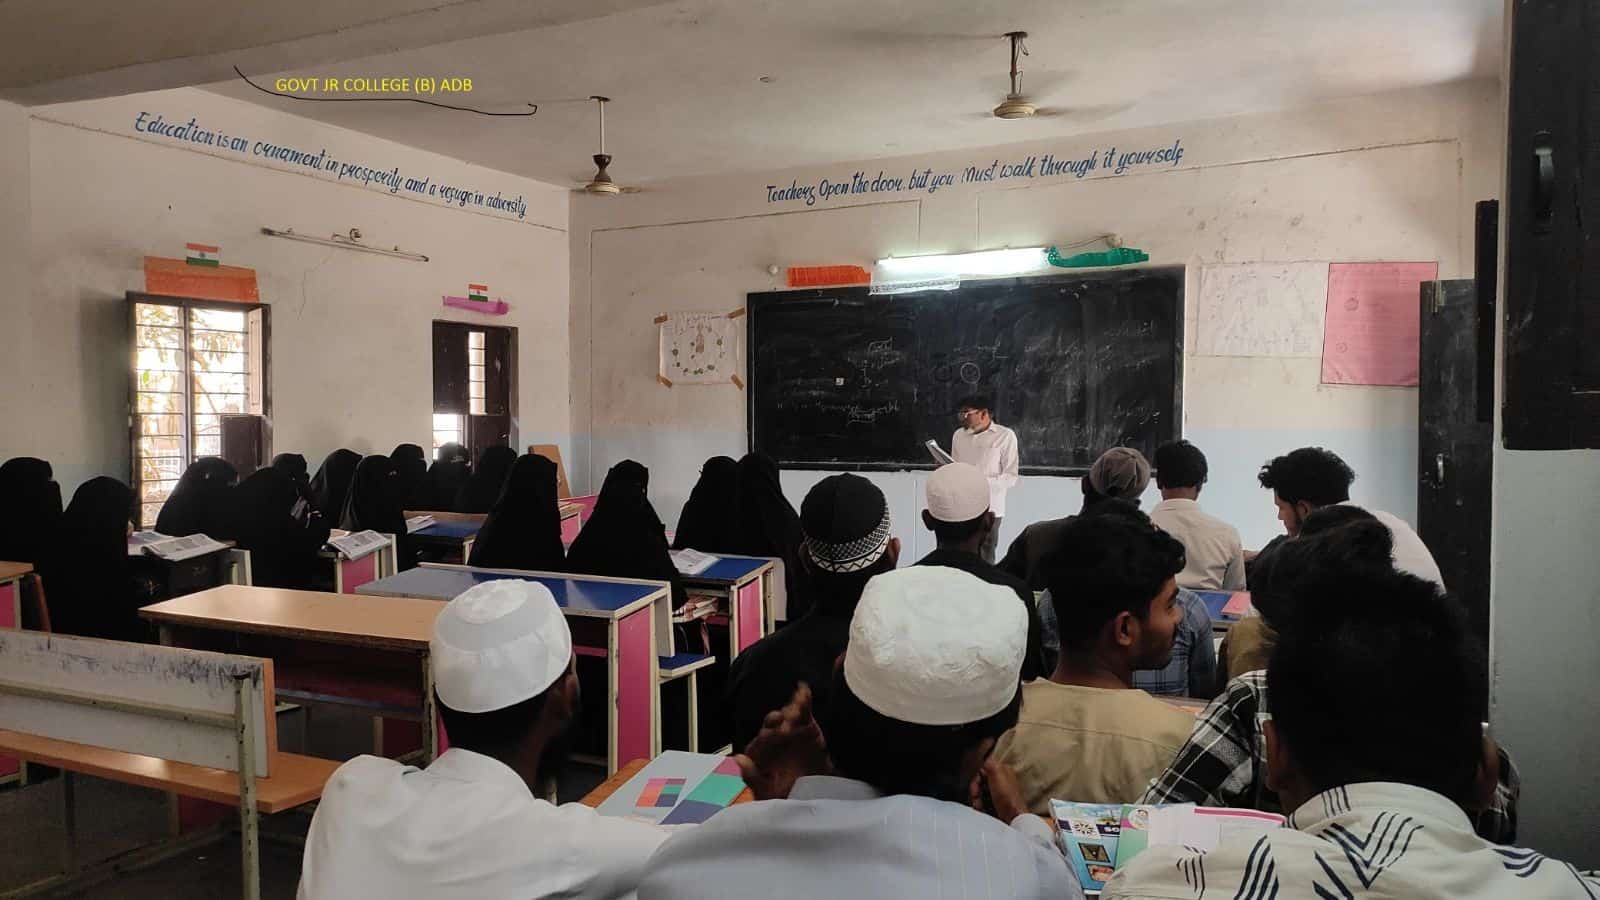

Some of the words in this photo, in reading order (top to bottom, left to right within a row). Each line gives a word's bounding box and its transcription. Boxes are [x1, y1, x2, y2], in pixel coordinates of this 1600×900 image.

[135, 111, 214, 145] Education
[216, 130, 230, 148] is
[231, 137, 249, 153] an
[253, 141, 325, 170] ornament
[325, 155, 339, 172] in
[338, 161, 403, 194] prosperity
[405, 177, 429, 194] and
[429, 184, 437, 196] a
[474, 190, 485, 206] in
[486, 191, 527, 219] adversity
[766, 179, 816, 206] Teachers
[819, 179, 849, 200] Open
[851, 171, 870, 194] the
[908, 168, 932, 190] but
[930, 173, 954, 193] you
[961, 159, 998, 183] Must
[1000, 155, 1036, 178] walk
[1040, 150, 1097, 178] through
[1103, 147, 1116, 168] it
[1115, 138, 1185, 174] yourself
